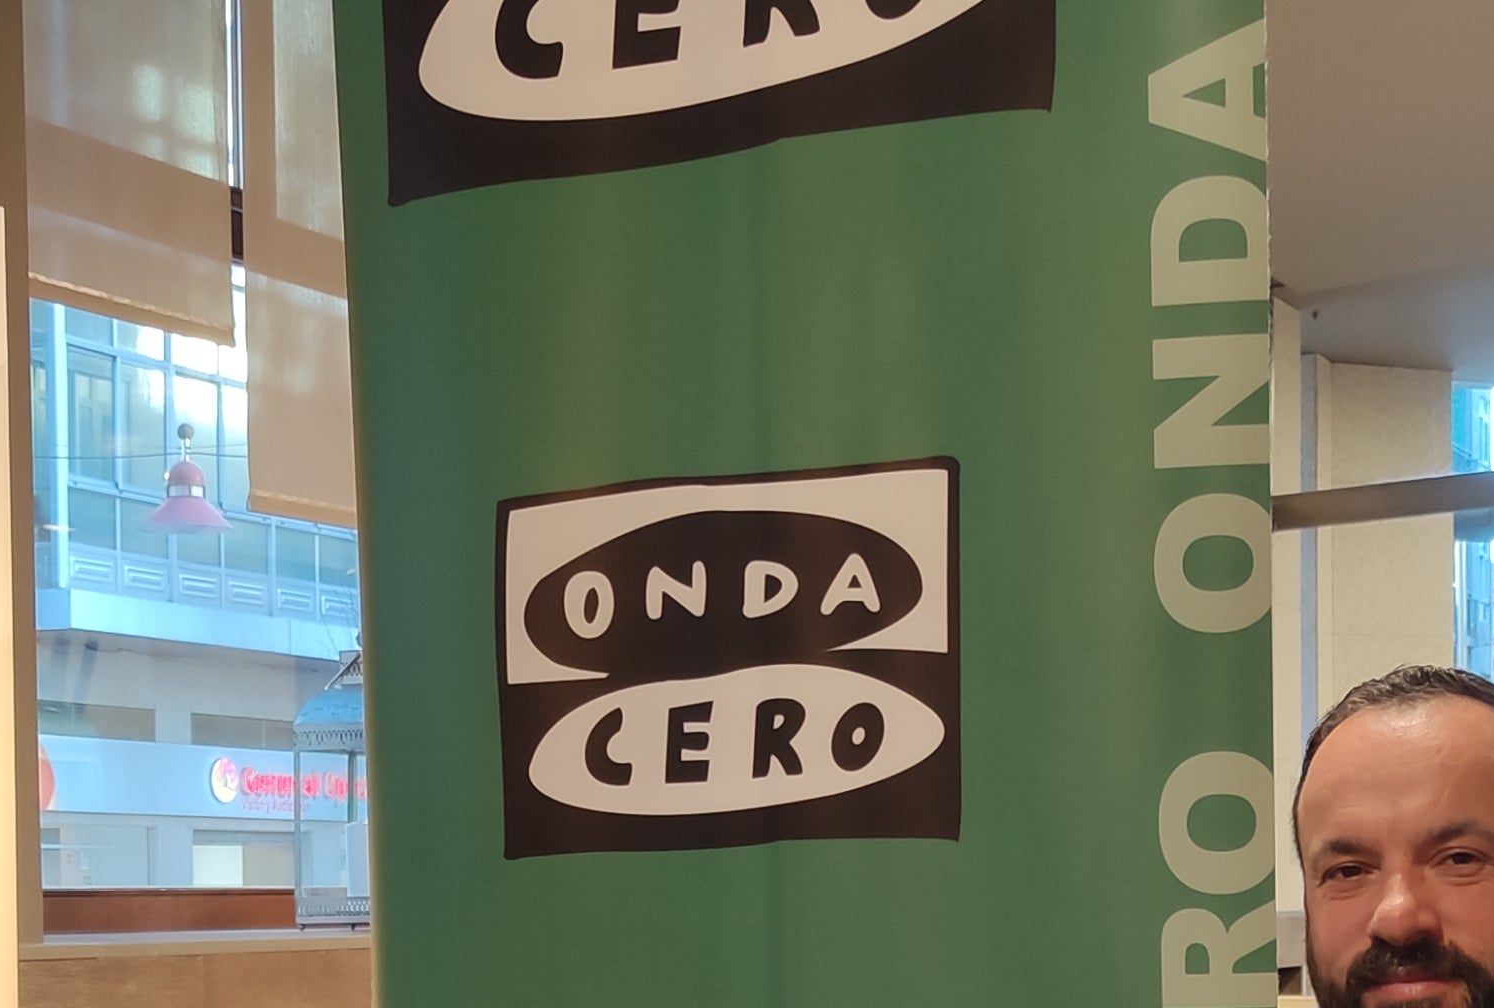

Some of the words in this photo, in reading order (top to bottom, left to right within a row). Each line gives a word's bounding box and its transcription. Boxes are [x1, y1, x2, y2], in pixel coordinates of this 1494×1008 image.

[496, 0, 916, 79] CE
[1148, 18, 1273, 633] ONDA
[564, 554, 880, 639] ONDA
[585, 698, 885, 786] CERO
